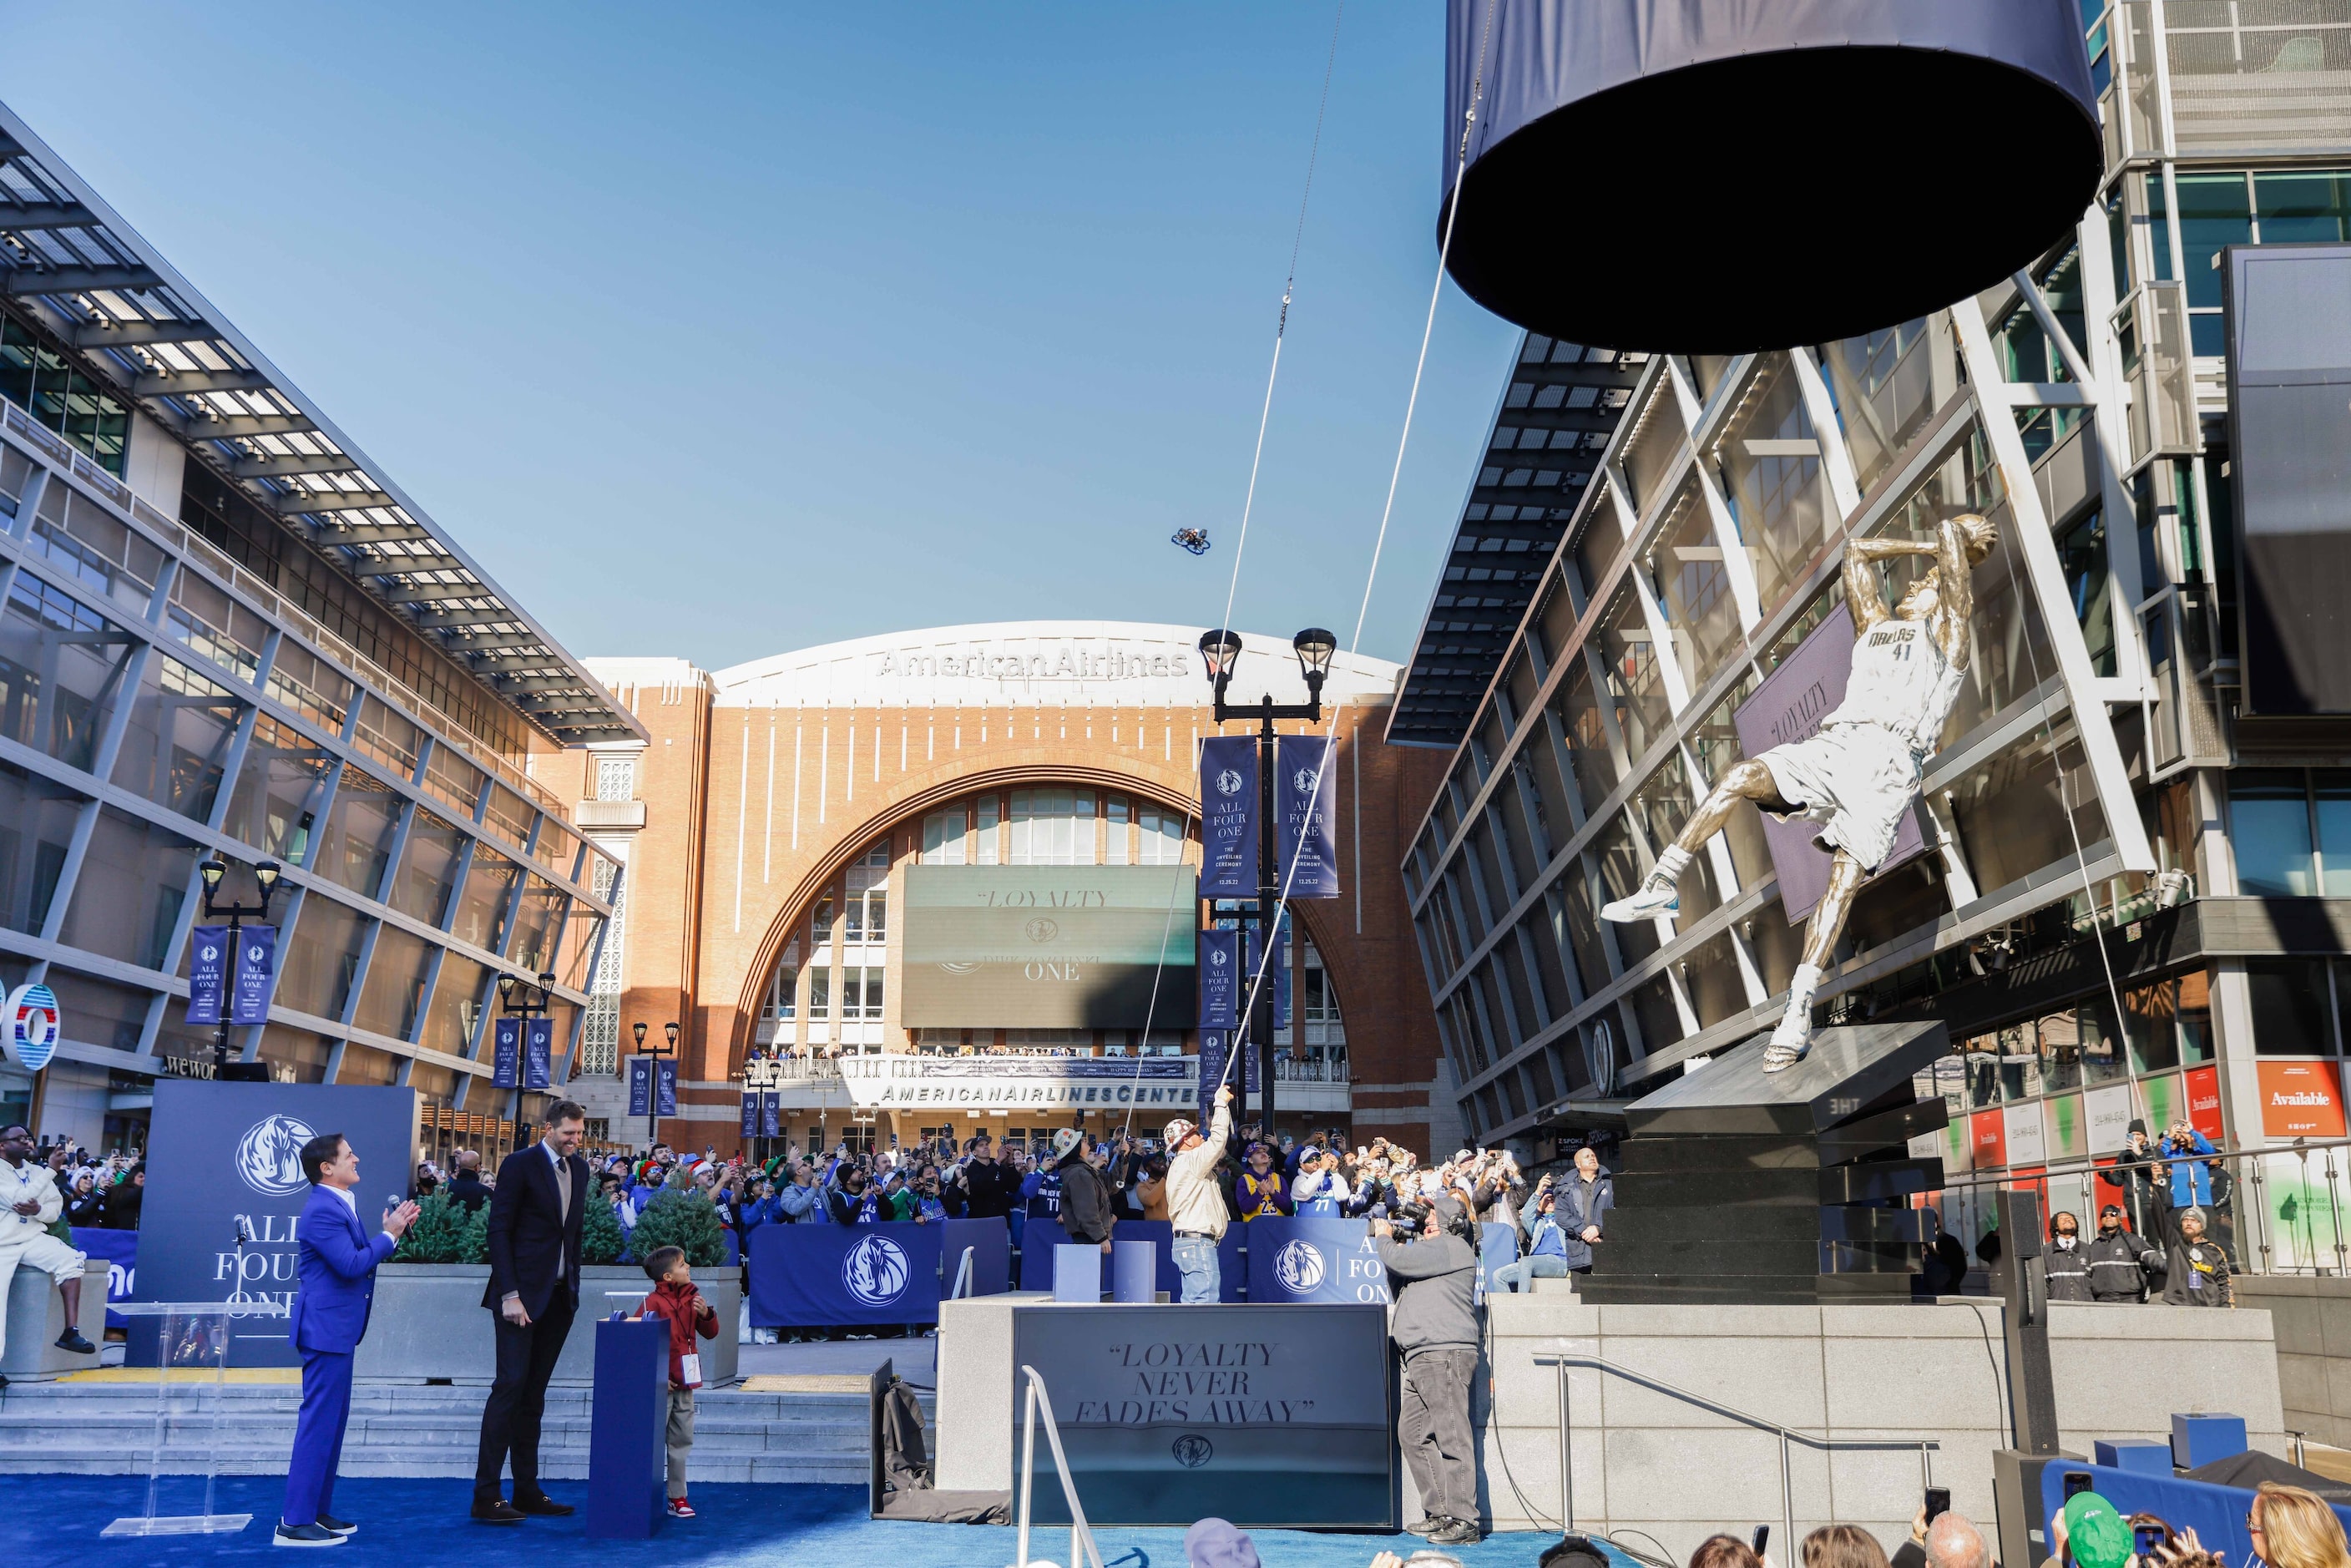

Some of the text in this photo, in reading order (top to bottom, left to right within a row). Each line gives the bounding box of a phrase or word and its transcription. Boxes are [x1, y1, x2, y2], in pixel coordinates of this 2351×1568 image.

[1868, 628, 1916, 647] DALLAS
[1893, 643, 1911, 661] 41
[1218, 802, 1241, 813] ALL
[1294, 801, 1318, 811] ALL
[1213, 814, 1246, 826] FOUR
[1289, 814, 1323, 823] FOUR
[1218, 826, 1242, 838] ONE
[1293, 826, 1319, 836] ONE
[1024, 963, 1079, 981] ONE
[167, 1055, 217, 1080] wewor
[2192, 1095, 2218, 1111] Available
[2271, 1092, 2330, 1106] Available
[1260, 1200, 1277, 1215] 23
[1315, 1199, 1329, 1212] 77
[213, 1253, 301, 1281] FOU
[1357, 1284, 1392, 1303] ON
[1109, 1343, 1280, 1366] “LOYALTY
[1131, 1371, 1252, 1395] NEVER
[1075, 1400, 1315, 1424] FADES AWAY”
